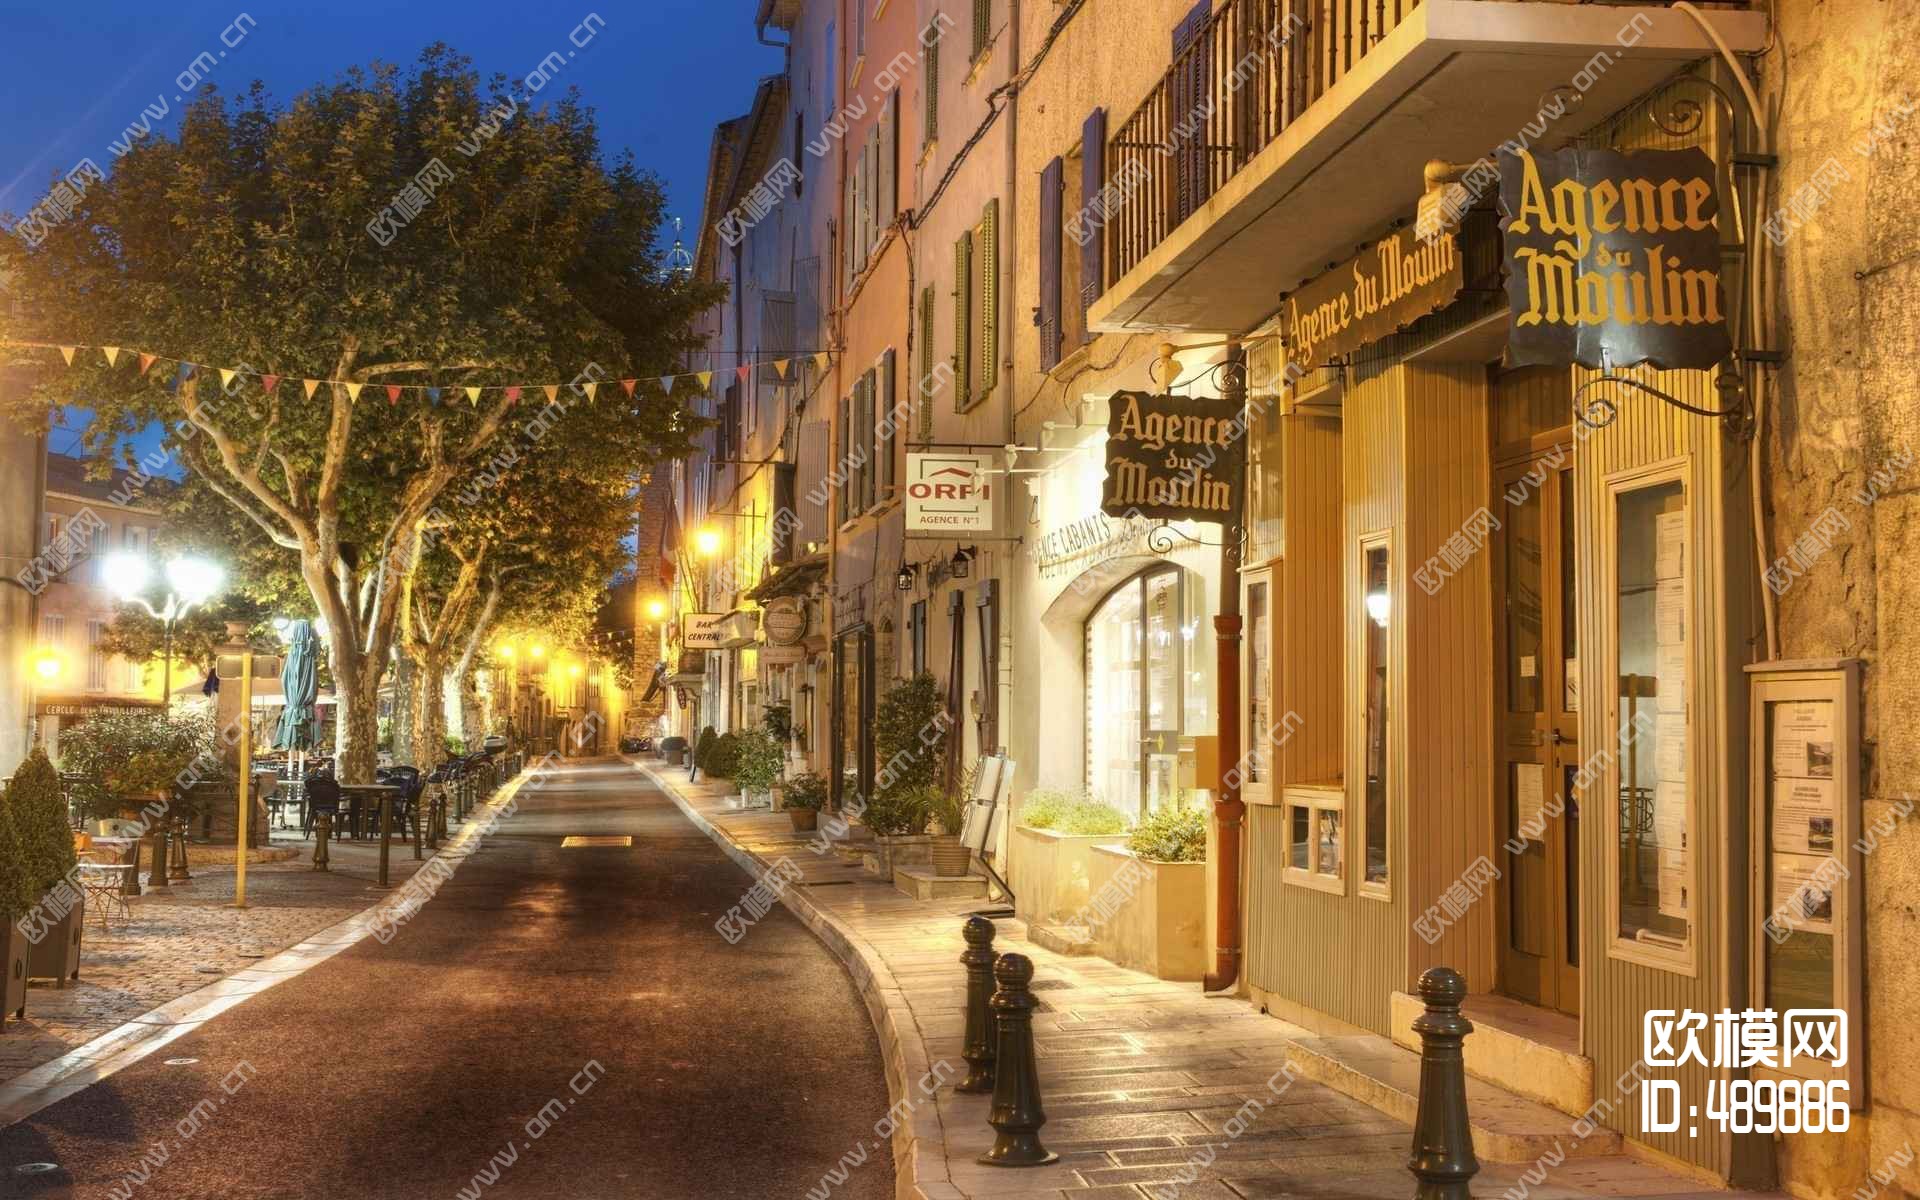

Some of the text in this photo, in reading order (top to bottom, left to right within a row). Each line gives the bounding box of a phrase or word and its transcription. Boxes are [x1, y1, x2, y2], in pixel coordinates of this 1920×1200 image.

[1508, 148, 1712, 260] Agence
[1596, 241, 1632, 267] du
[1288, 232, 1453, 366] Agence du Moulin
[1514, 243, 1725, 328] Moulin
[1112, 395, 1233, 450] Agence
[1165, 449, 1192, 469] du
[1107, 457, 1230, 511] Moulin
[920, 516, 959, 525] AGENCE
[1059, 511, 1111, 553] CABANIS
[688, 633, 721, 641] CENTRAL
